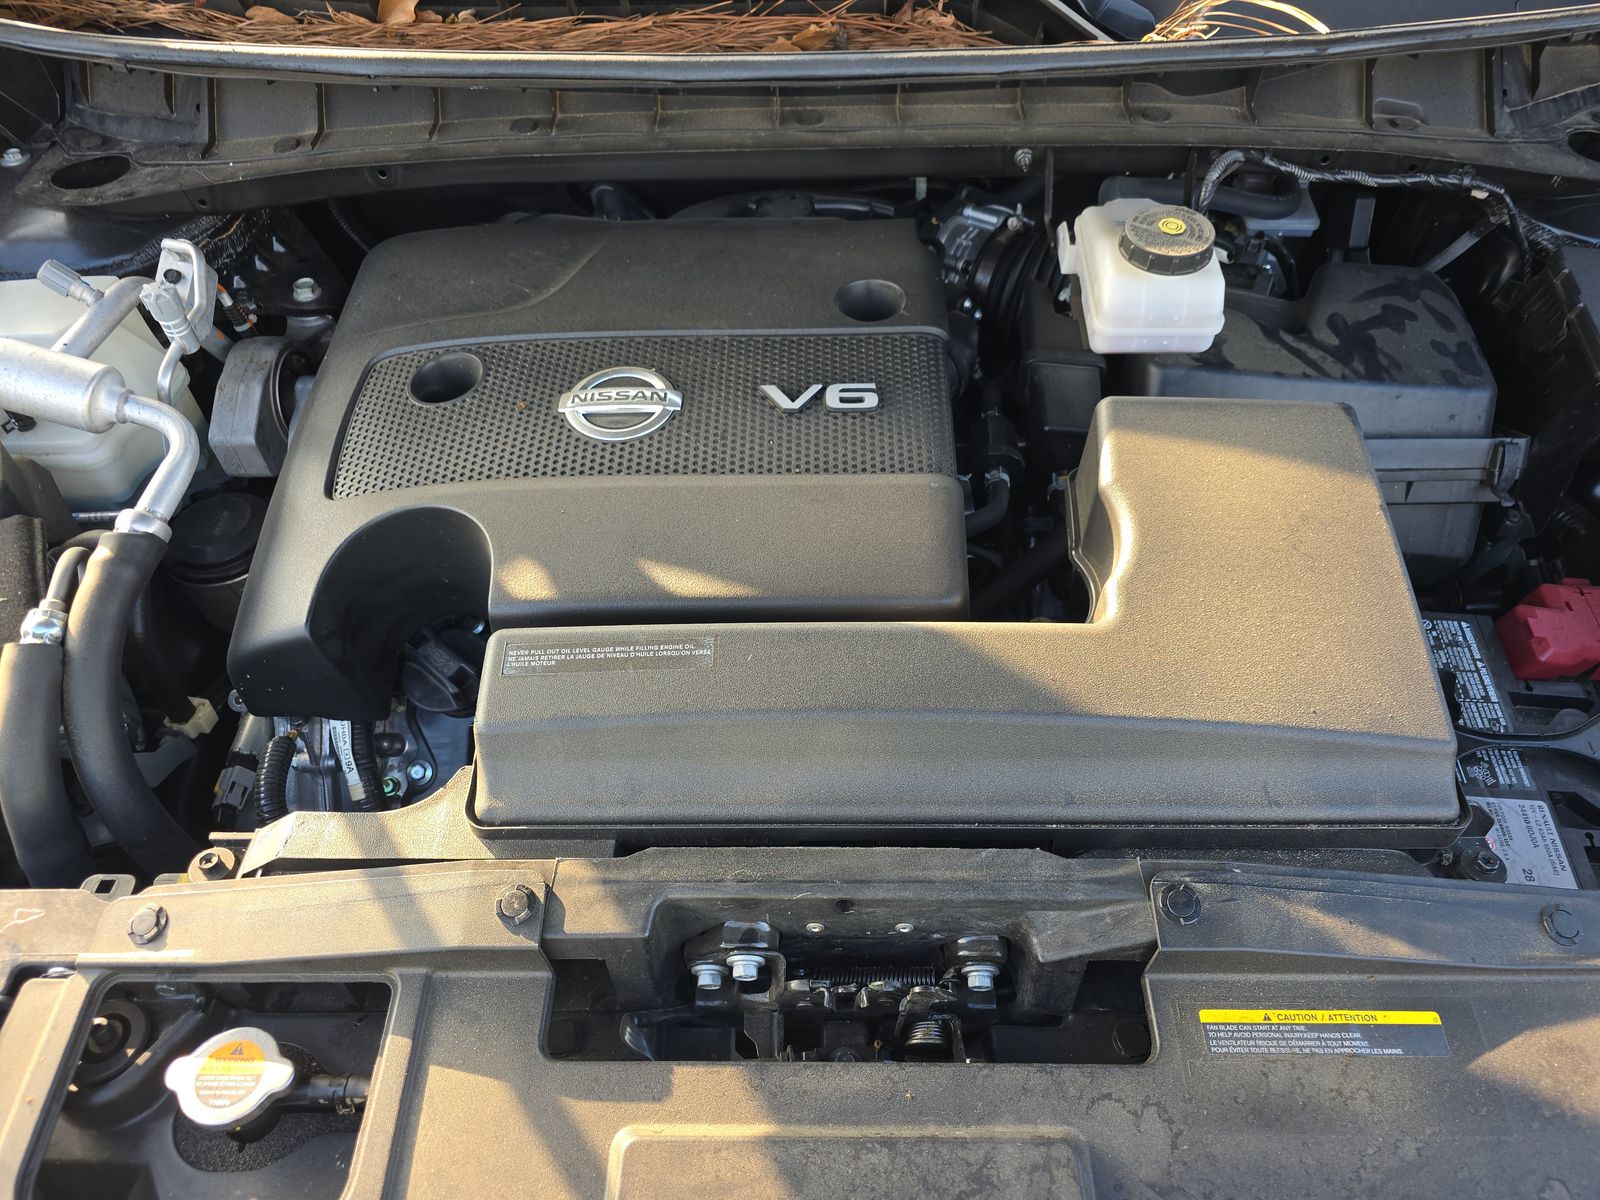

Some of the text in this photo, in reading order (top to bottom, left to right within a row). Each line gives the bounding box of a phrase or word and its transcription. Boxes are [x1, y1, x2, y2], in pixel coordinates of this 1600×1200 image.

[570, 390, 669, 404] NISSAN
[759, 383, 879, 412] V6
[1537, 804, 1567, 872] RENAULT NISSAN
[1522, 868, 1536, 882] 28
[1277, 1013, 1318, 1022] CAUTION
[1328, 1014, 1378, 1022] ATTENTION
[1288, 1039, 1321, 1047] DÉMARRER
[214, 1055, 257, 1064] WARNING
